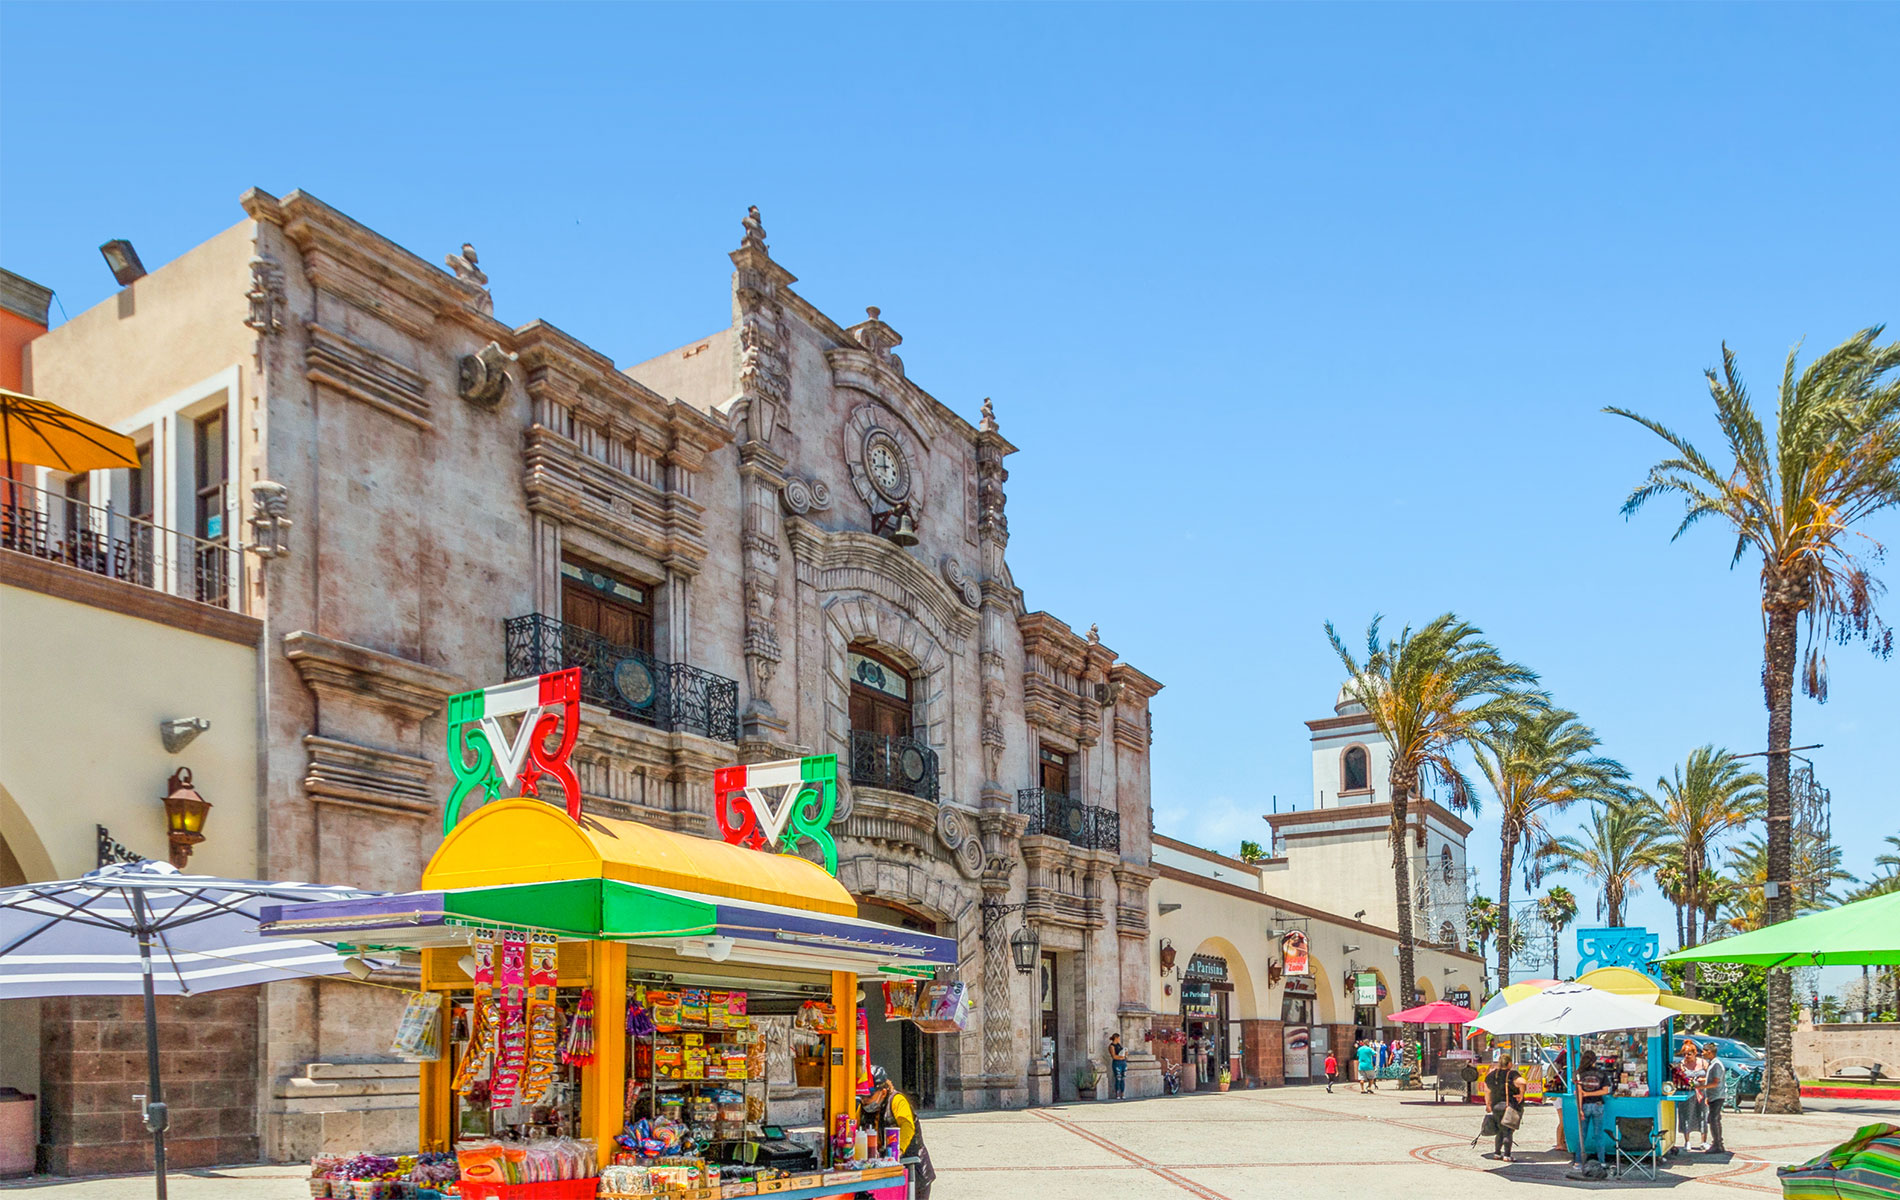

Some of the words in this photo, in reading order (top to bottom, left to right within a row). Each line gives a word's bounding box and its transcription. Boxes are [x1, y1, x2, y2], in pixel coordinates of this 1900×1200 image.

[1196, 961, 1223, 976] Parisina
[1288, 964, 1304, 972] Zone
[1357, 989, 1375, 1001] Shoes
